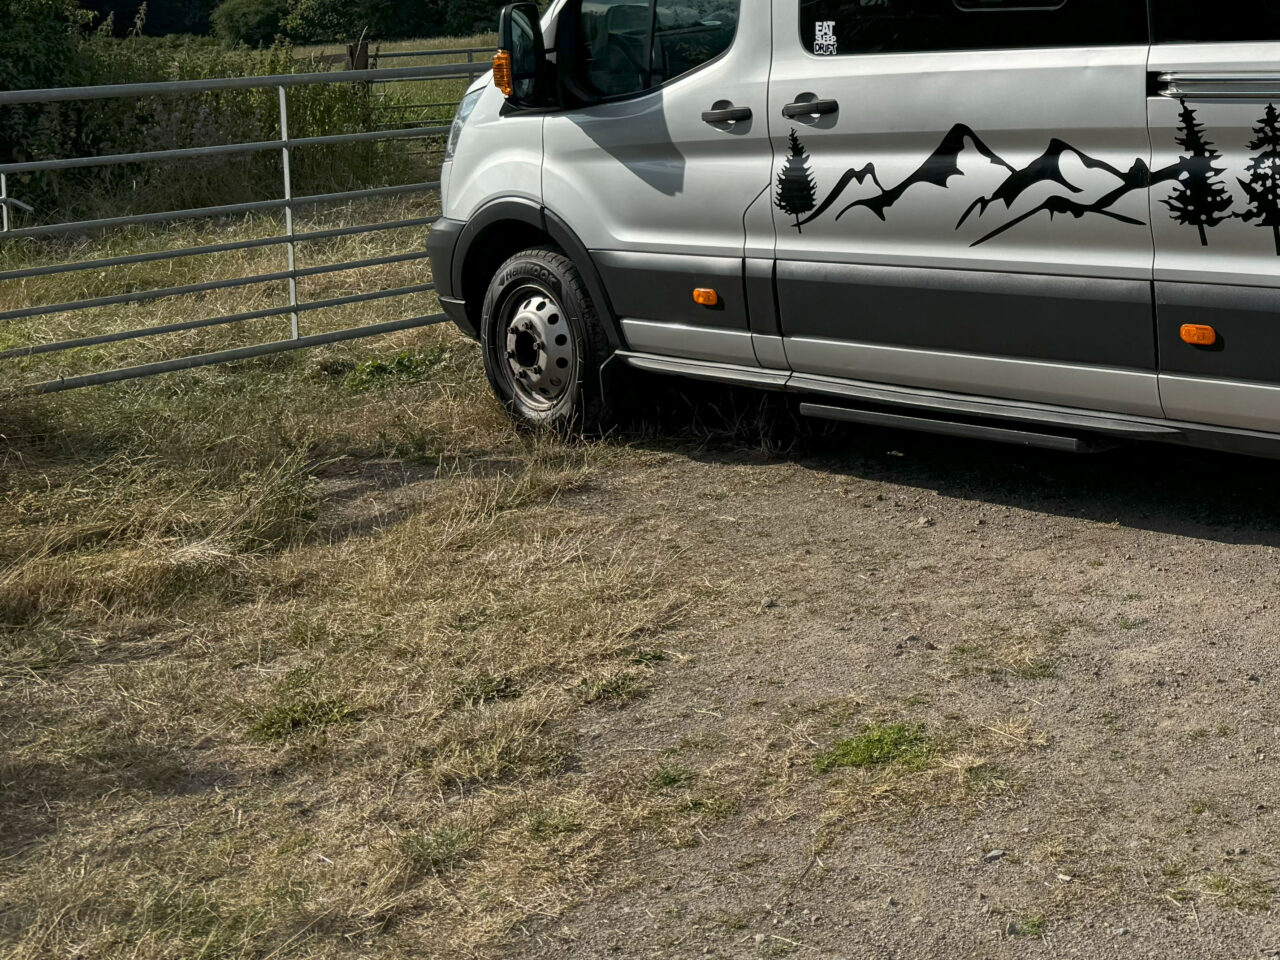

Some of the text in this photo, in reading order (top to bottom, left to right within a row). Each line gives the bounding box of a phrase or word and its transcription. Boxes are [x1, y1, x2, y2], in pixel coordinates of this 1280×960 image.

[815, 21, 836, 35] EAT
[815, 35, 837, 43] SLEEP
[814, 42, 837, 54] DRIFT
